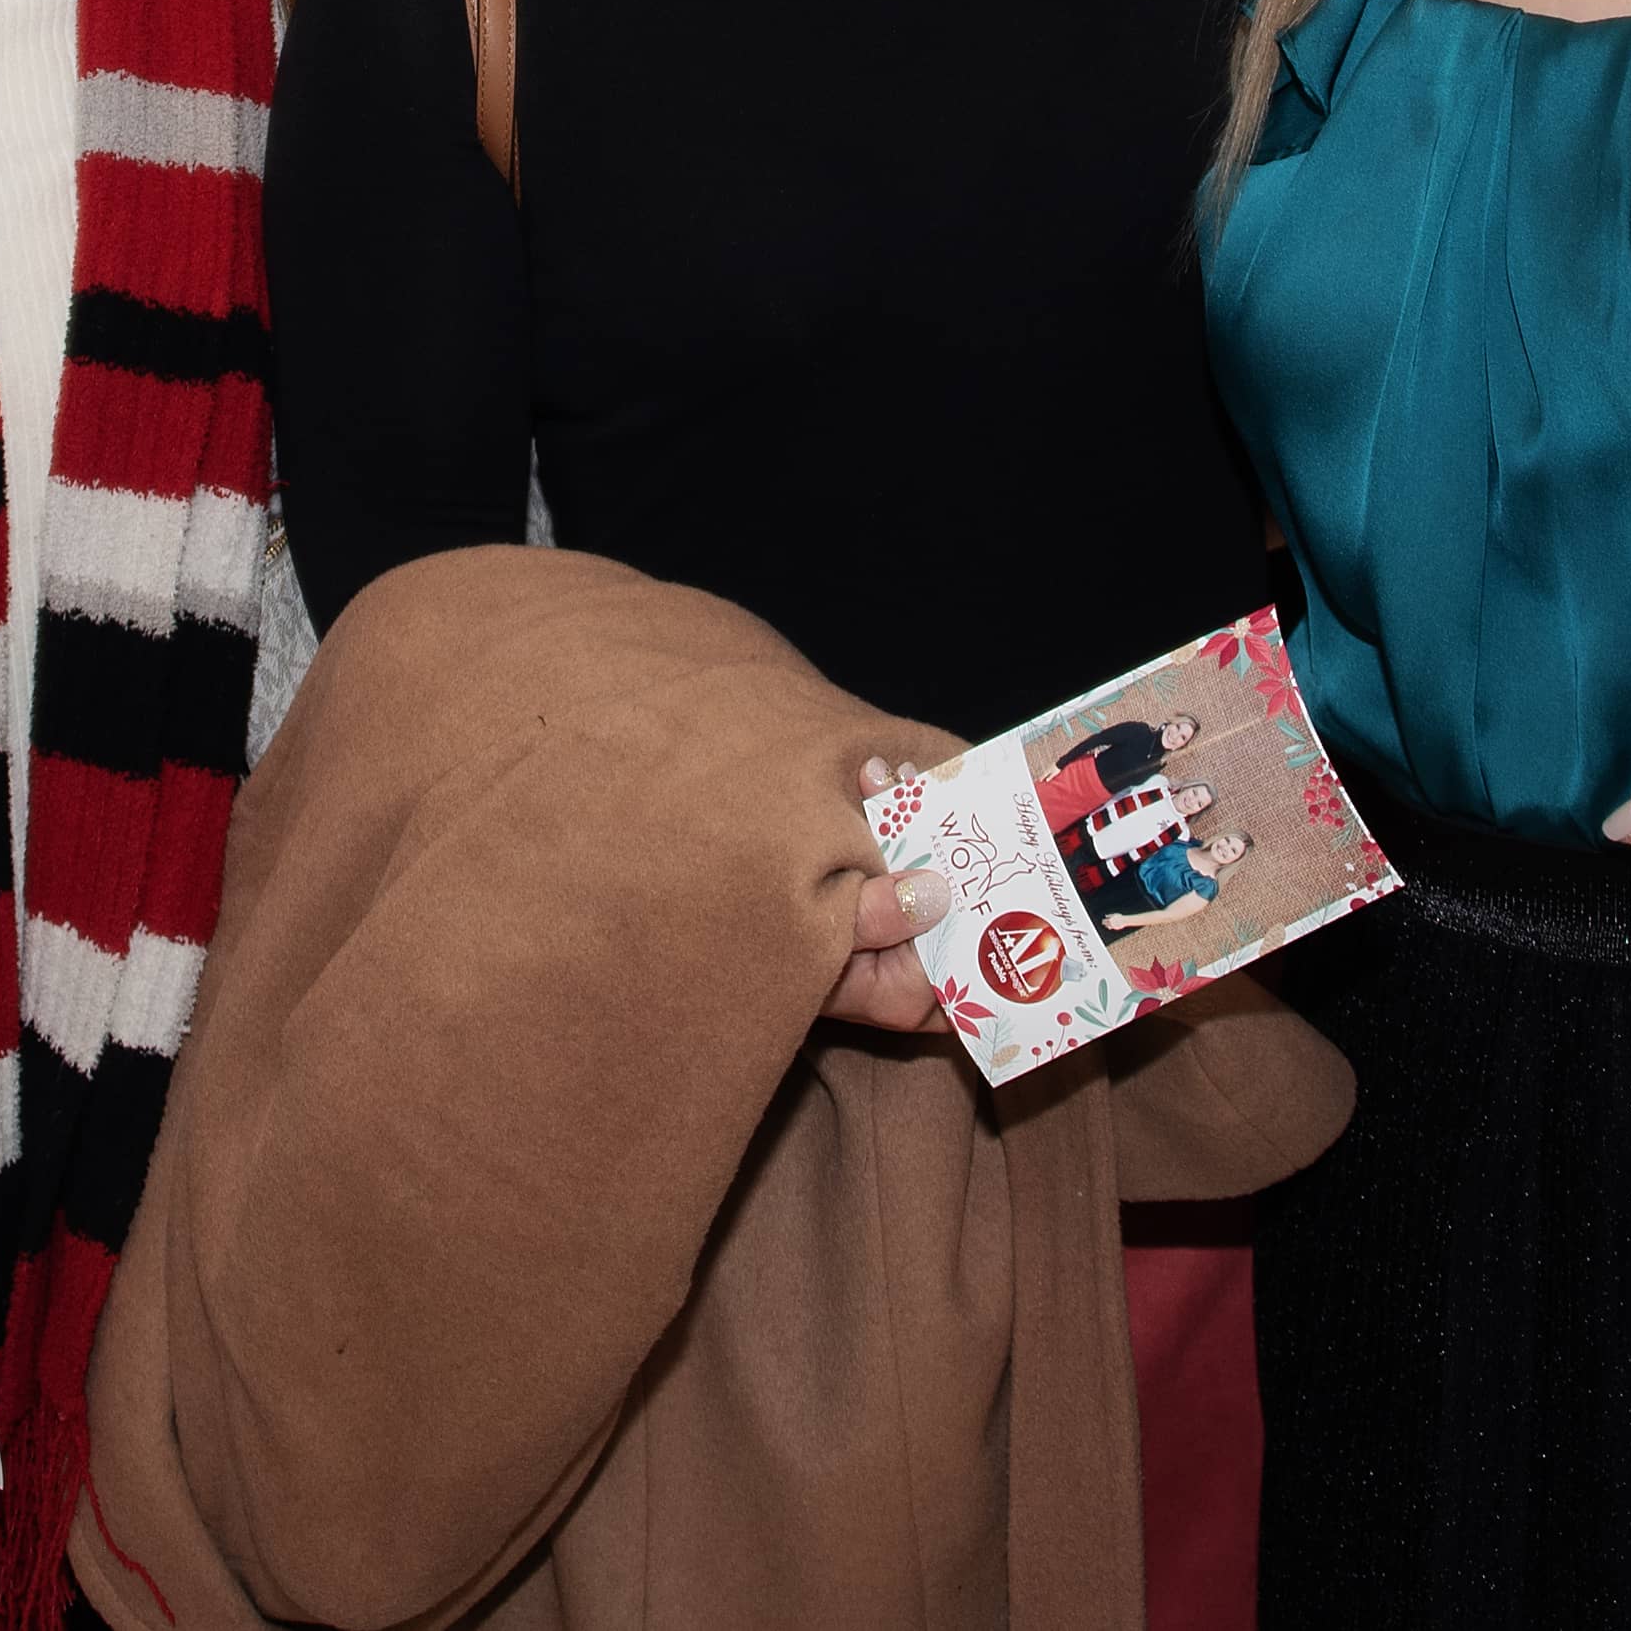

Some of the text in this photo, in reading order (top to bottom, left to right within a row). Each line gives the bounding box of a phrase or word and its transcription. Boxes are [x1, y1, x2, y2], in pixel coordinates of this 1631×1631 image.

[930, 835, 966, 913] AESTHETICS
[939, 811, 992, 915] WOLF
[1014, 792, 1098, 969] Happy Holidays from:
[987, 952, 1007, 983] Pueblo
